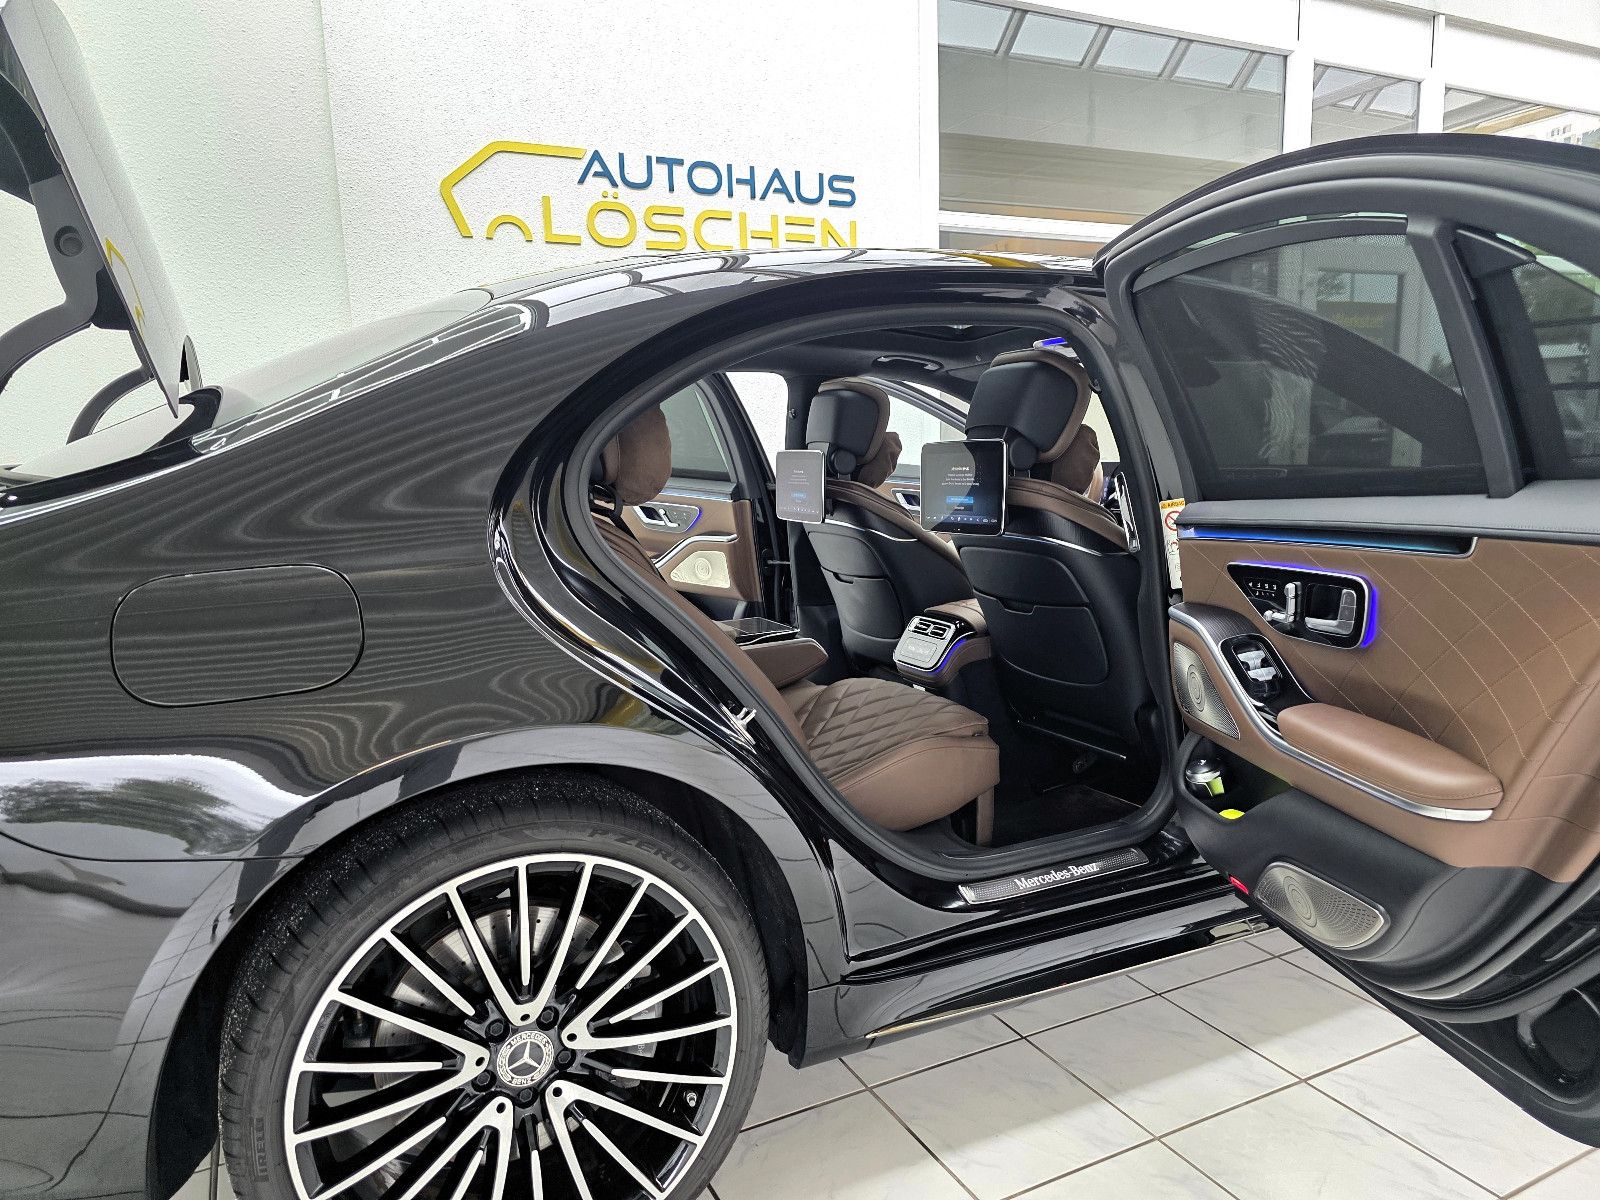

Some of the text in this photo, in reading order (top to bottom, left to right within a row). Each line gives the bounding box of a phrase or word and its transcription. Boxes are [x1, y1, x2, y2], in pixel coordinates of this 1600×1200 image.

[577, 149, 857, 206] AUTOHAUS
[542, 191, 856, 249] LÖSCHEN
[614, 833, 690, 872] ZERO
[1014, 862, 1099, 888] Mercedes-Benz
[510, 1032, 547, 1046] MERCEDES
